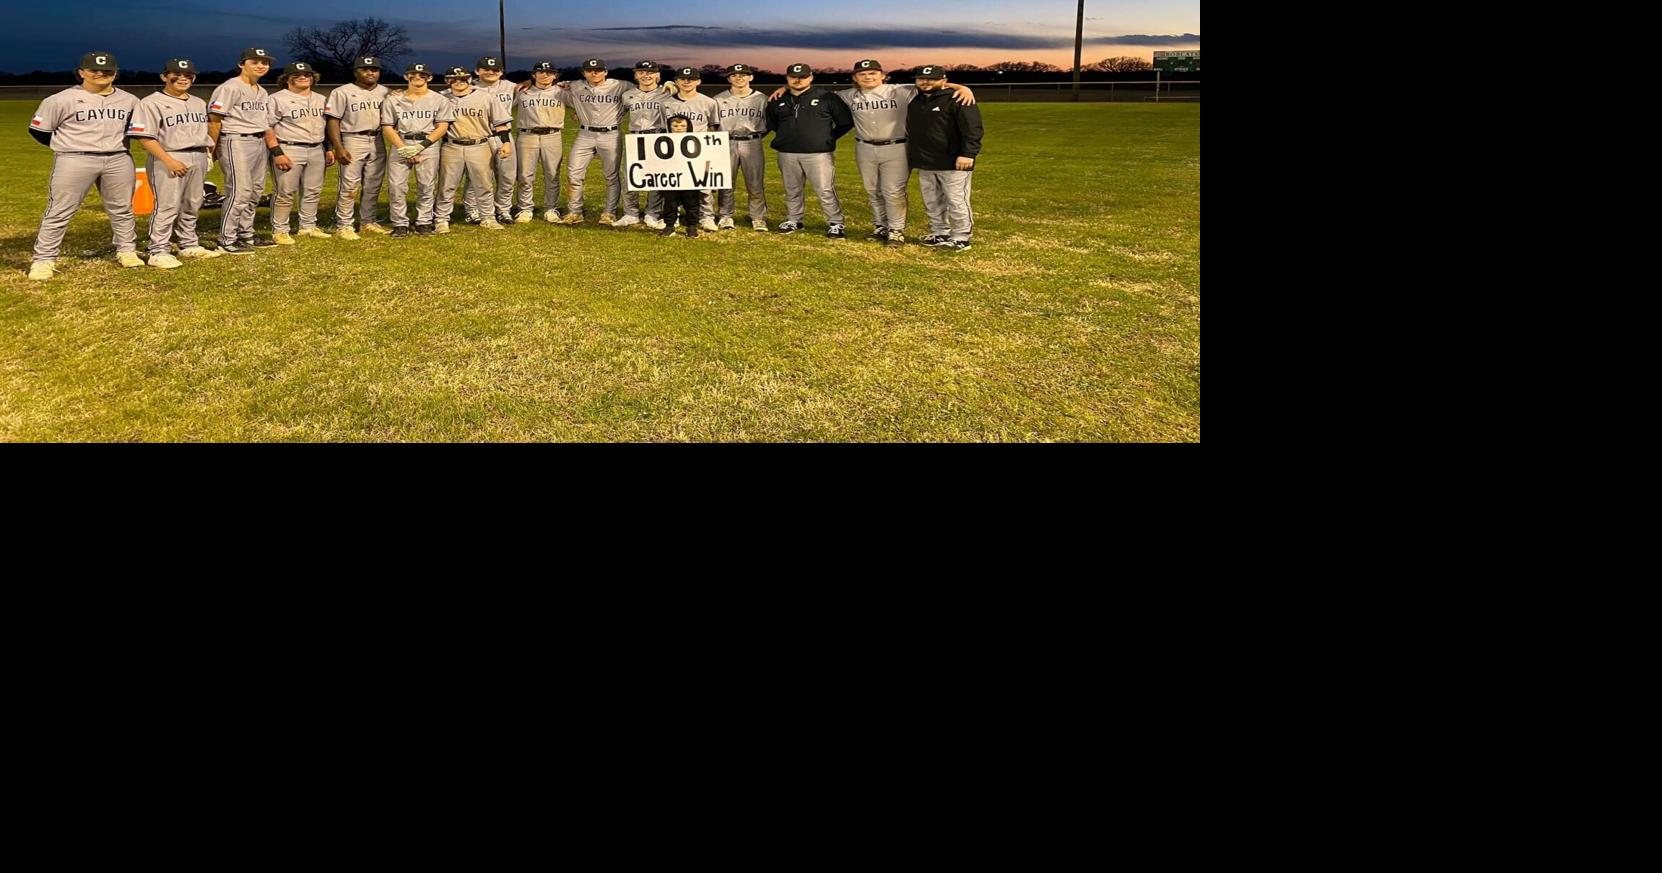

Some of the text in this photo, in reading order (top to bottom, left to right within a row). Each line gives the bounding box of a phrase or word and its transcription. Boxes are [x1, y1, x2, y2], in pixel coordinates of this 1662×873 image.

[95, 56, 107, 65] C
[178, 60, 188, 68] C
[793, 65, 802, 73] C
[922, 67, 933, 75] C
[522, 98, 562, 109] CAYUGA
[851, 99, 898, 112] CAYUGA
[452, 107, 483, 119] YUGA
[720, 107, 764, 119] CAYUGA
[629, 160, 724, 189] Career Win
